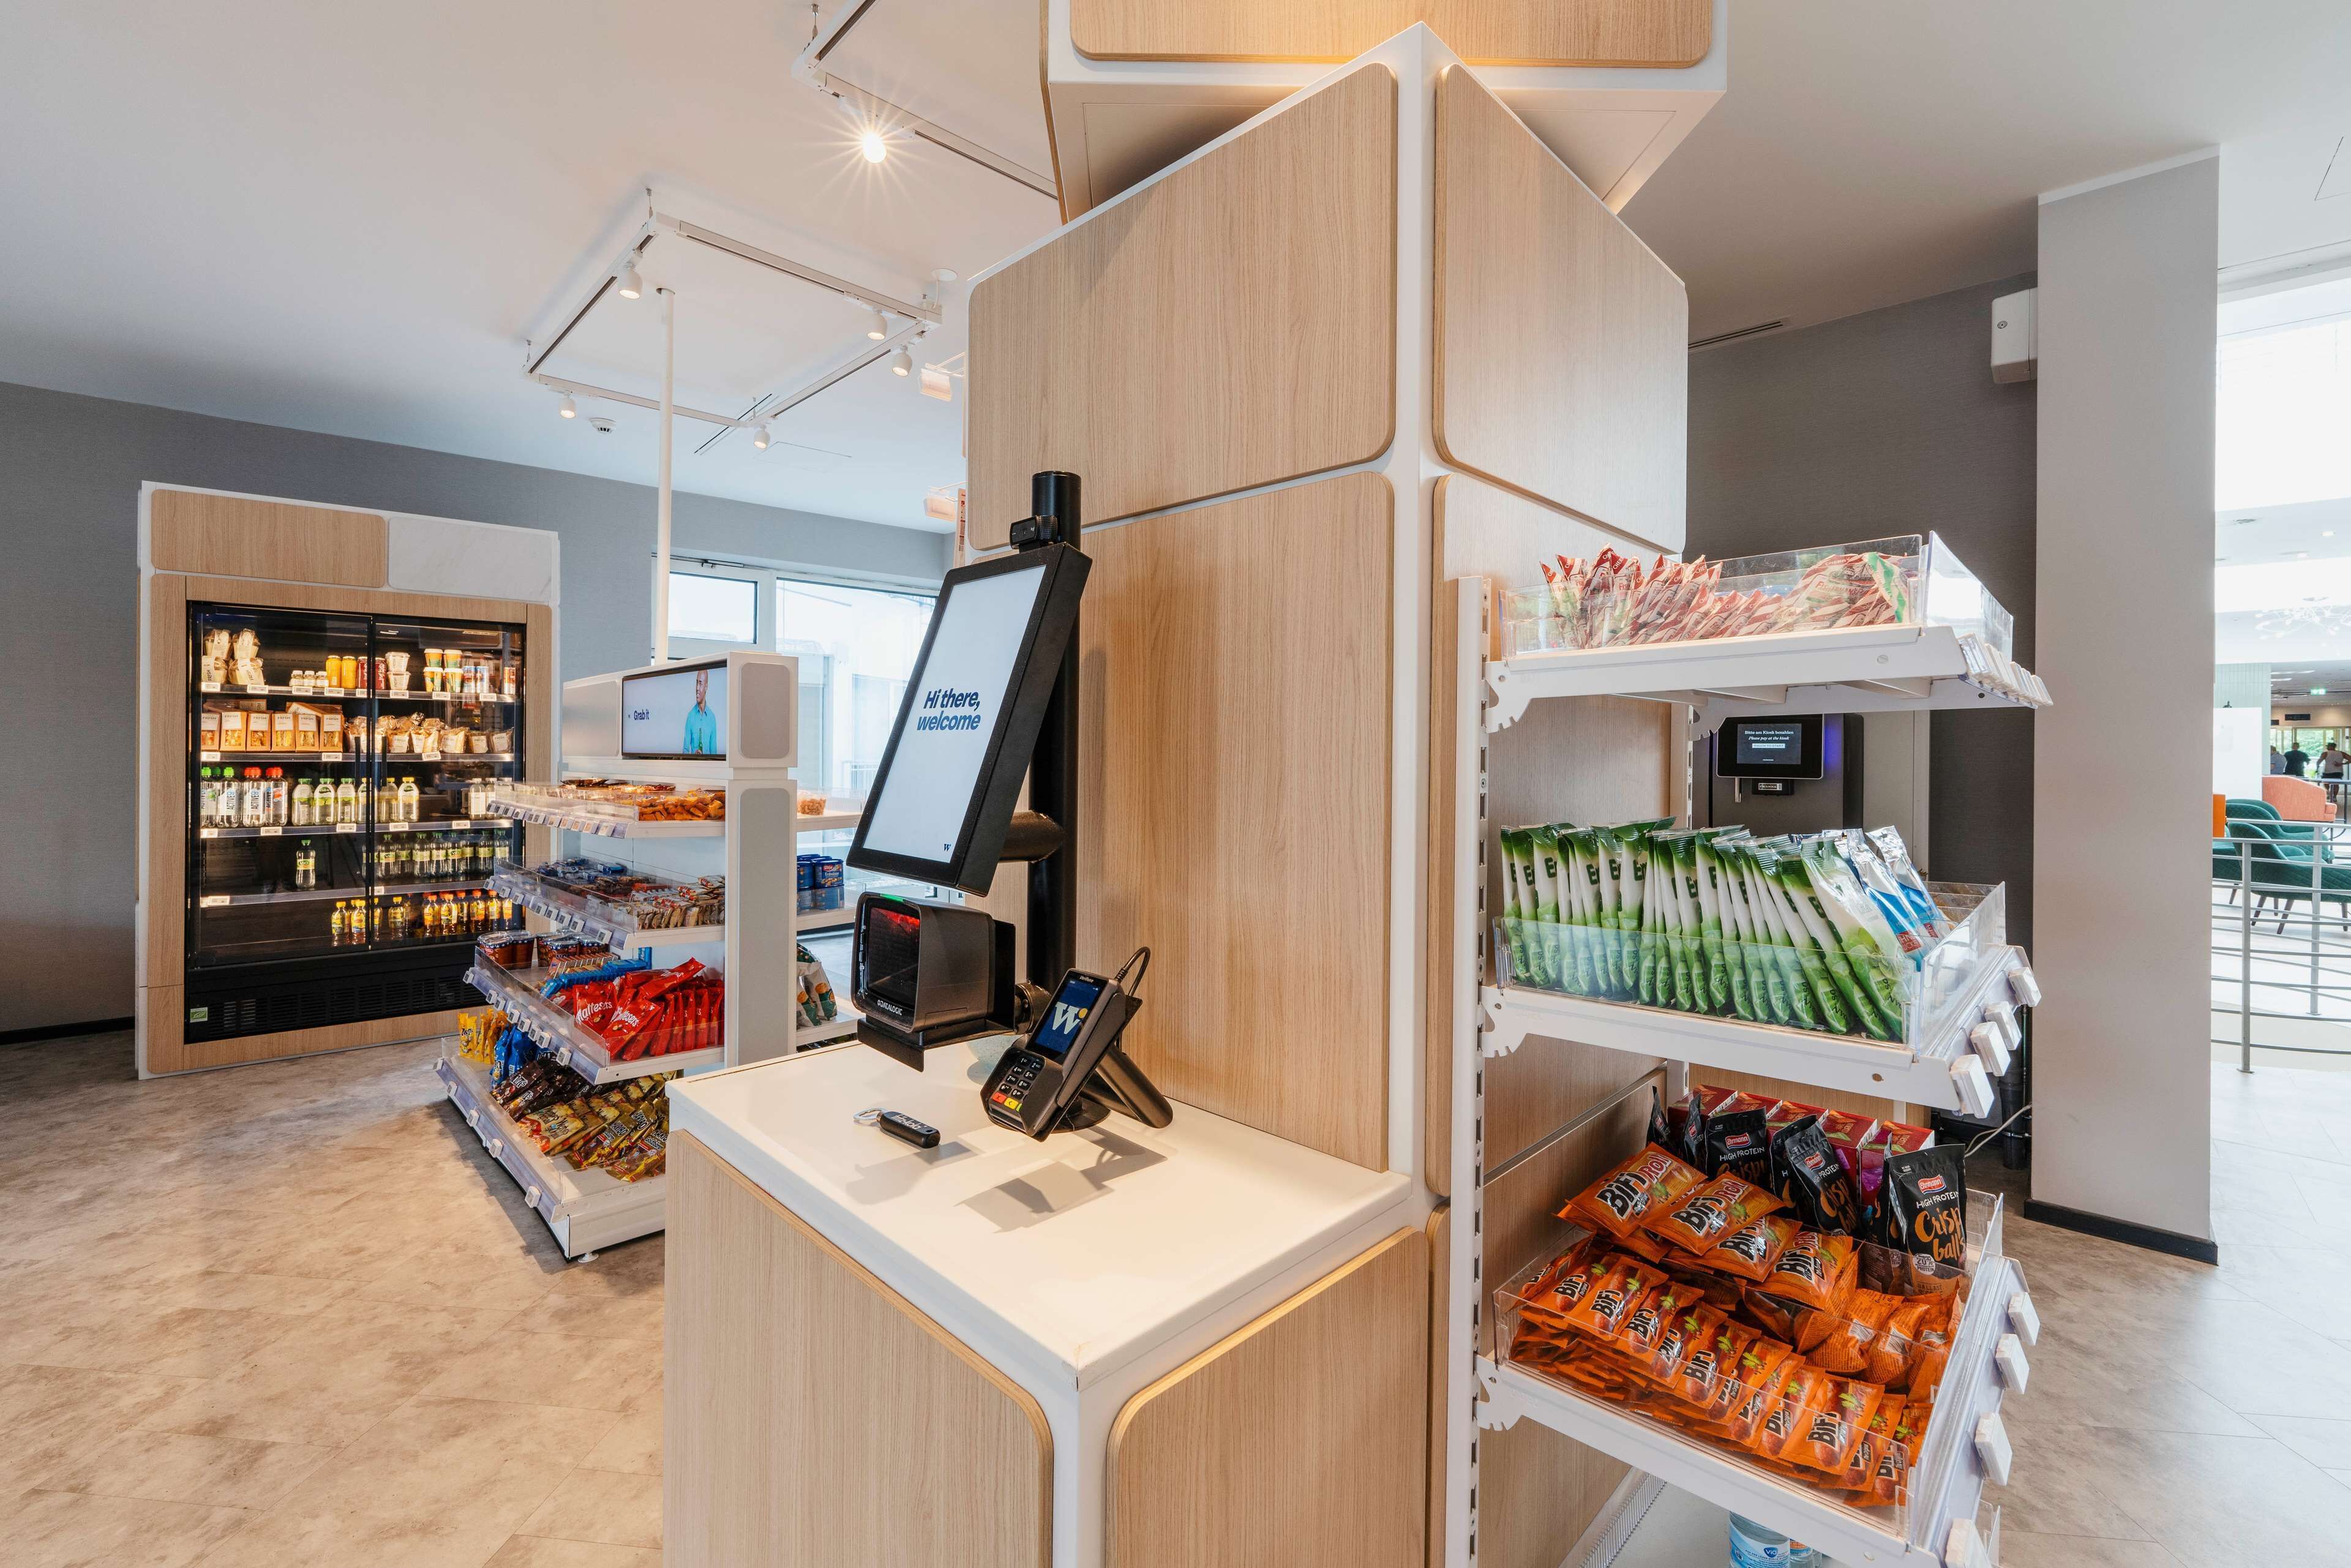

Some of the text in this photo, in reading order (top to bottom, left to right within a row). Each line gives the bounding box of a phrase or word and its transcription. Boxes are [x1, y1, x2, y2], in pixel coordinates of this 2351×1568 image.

[923, 688, 980, 711] Hi there,
[634, 708, 650, 721] Grab it
[917, 710, 981, 731] welcome
[227, 795, 235, 810] ACTIVE
[250, 795, 259, 809] ACTIVE
[880, 1000, 903, 1016] DATALOGIC
[1052, 1002, 1081, 1035] W
[1727, 1135, 1749, 1146] Ehrmann
[1719, 1146, 1765, 1162] HIGH PROTEIN
[1820, 1163, 1840, 1180] PROTEIN
[1919, 1177, 1943, 1190] Ehrmann
[1916, 1190, 1960, 1209] HIGH PROTEIN
[1916, 1256, 1935, 1267] 20%
